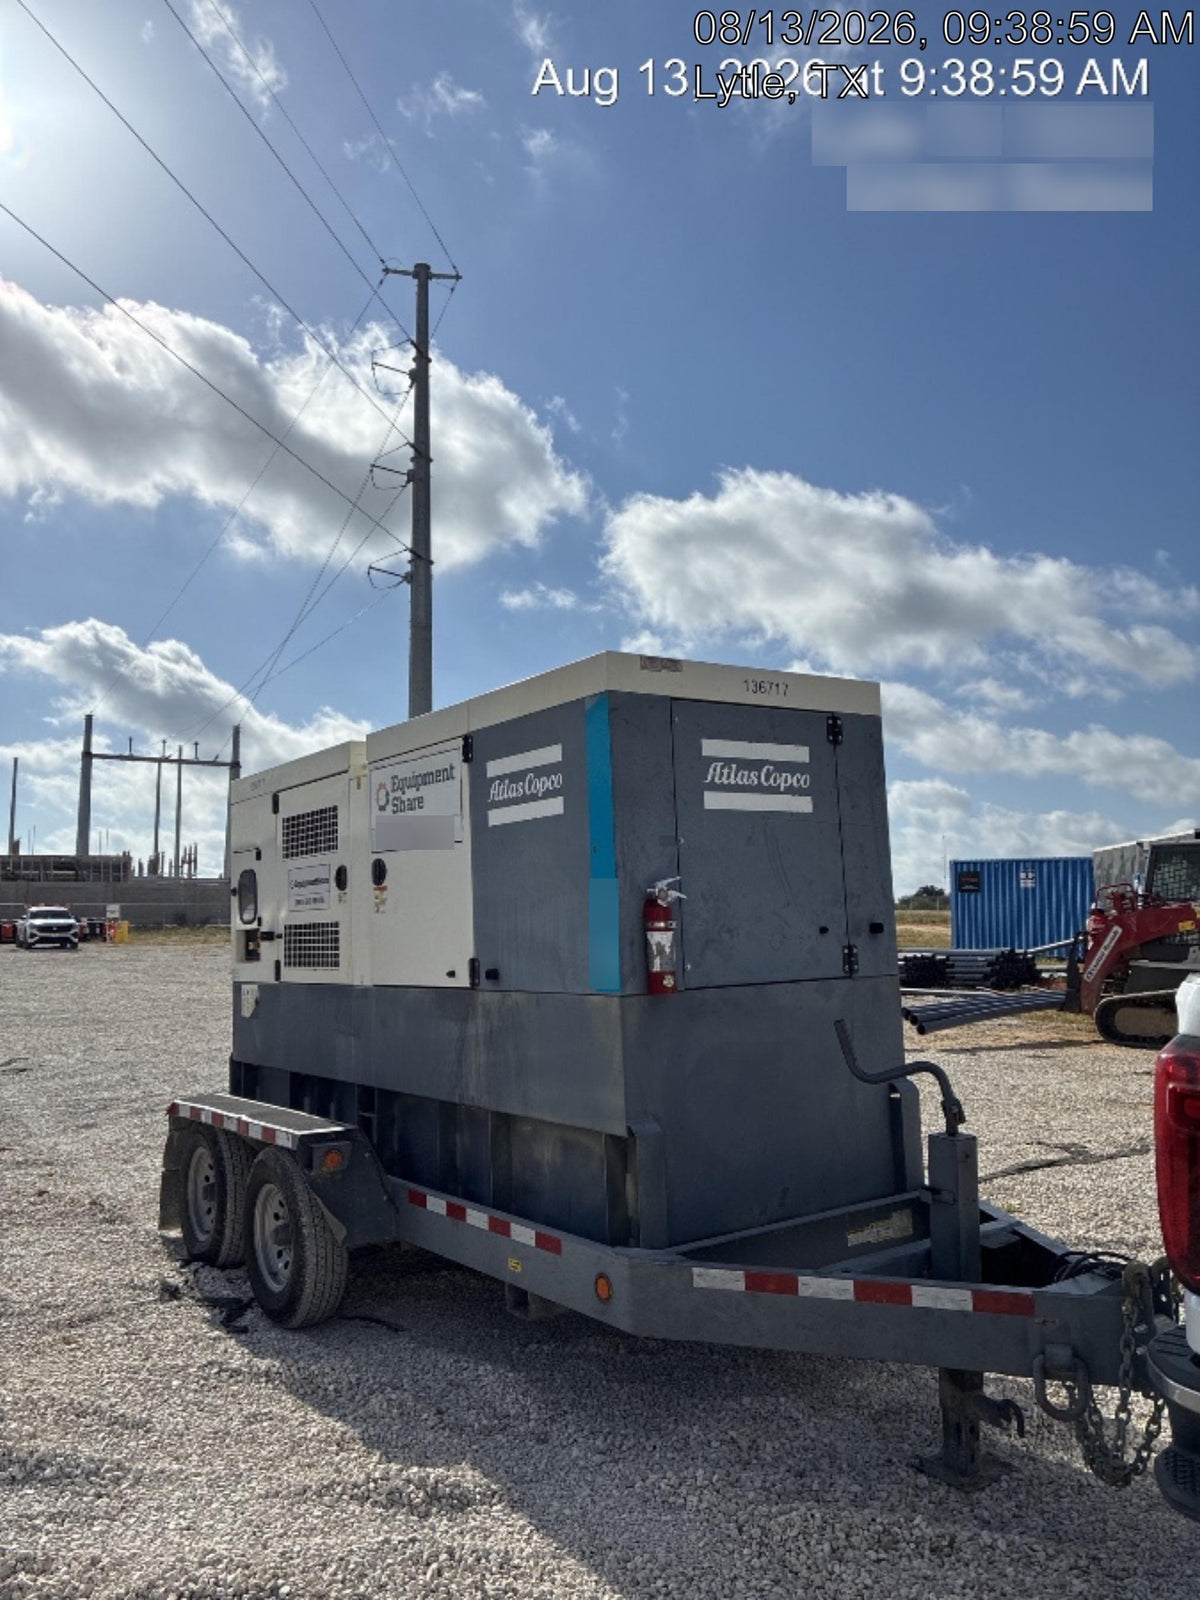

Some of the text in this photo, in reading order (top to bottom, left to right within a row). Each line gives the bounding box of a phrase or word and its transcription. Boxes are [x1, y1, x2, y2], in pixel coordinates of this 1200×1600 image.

[743, 679, 789, 696] 136717
[391, 763, 456, 795] Equipment
[488, 773, 563, 802] Atlas Copco
[704, 762, 811, 792] Atlas Copco
[391, 795, 425, 815] Share
